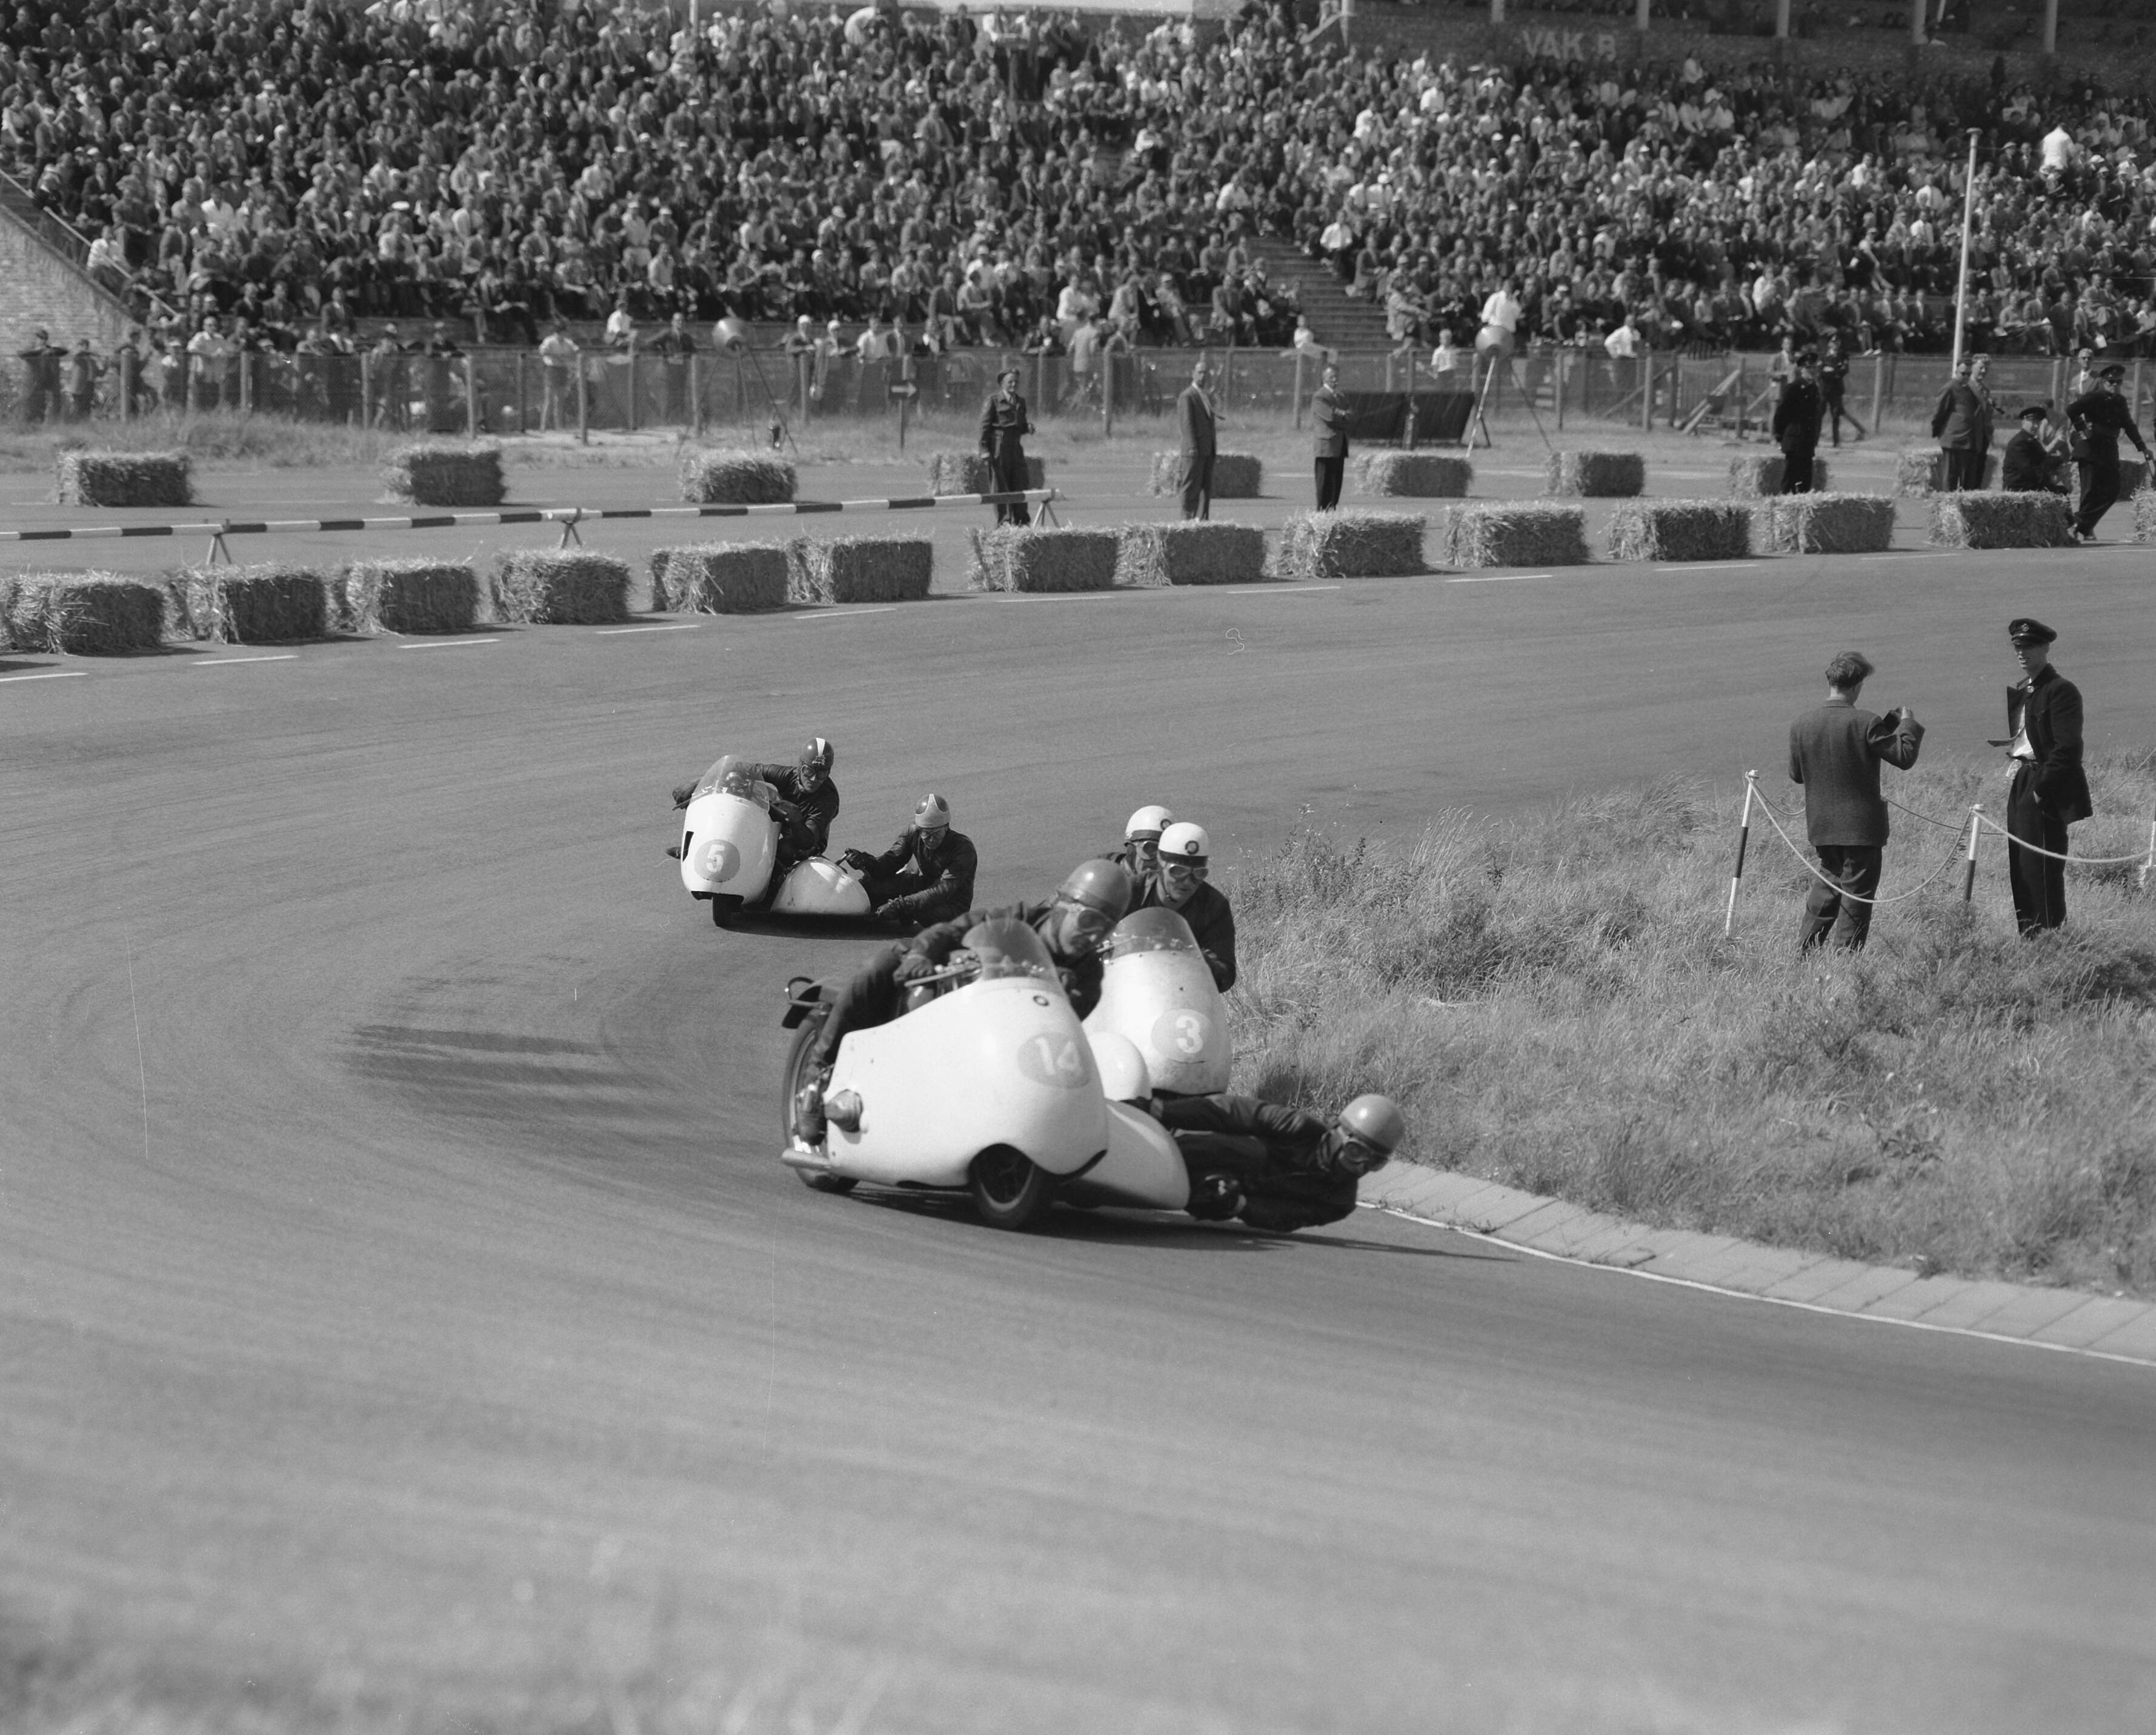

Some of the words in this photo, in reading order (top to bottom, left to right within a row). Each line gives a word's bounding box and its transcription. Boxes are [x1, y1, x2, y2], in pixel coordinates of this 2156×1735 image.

[1522, 30, 1584, 61] VAK
[707, 844, 725, 873] 5
[1176, 1016, 1203, 1053] 3
[1034, 1037, 1081, 1077] 14
